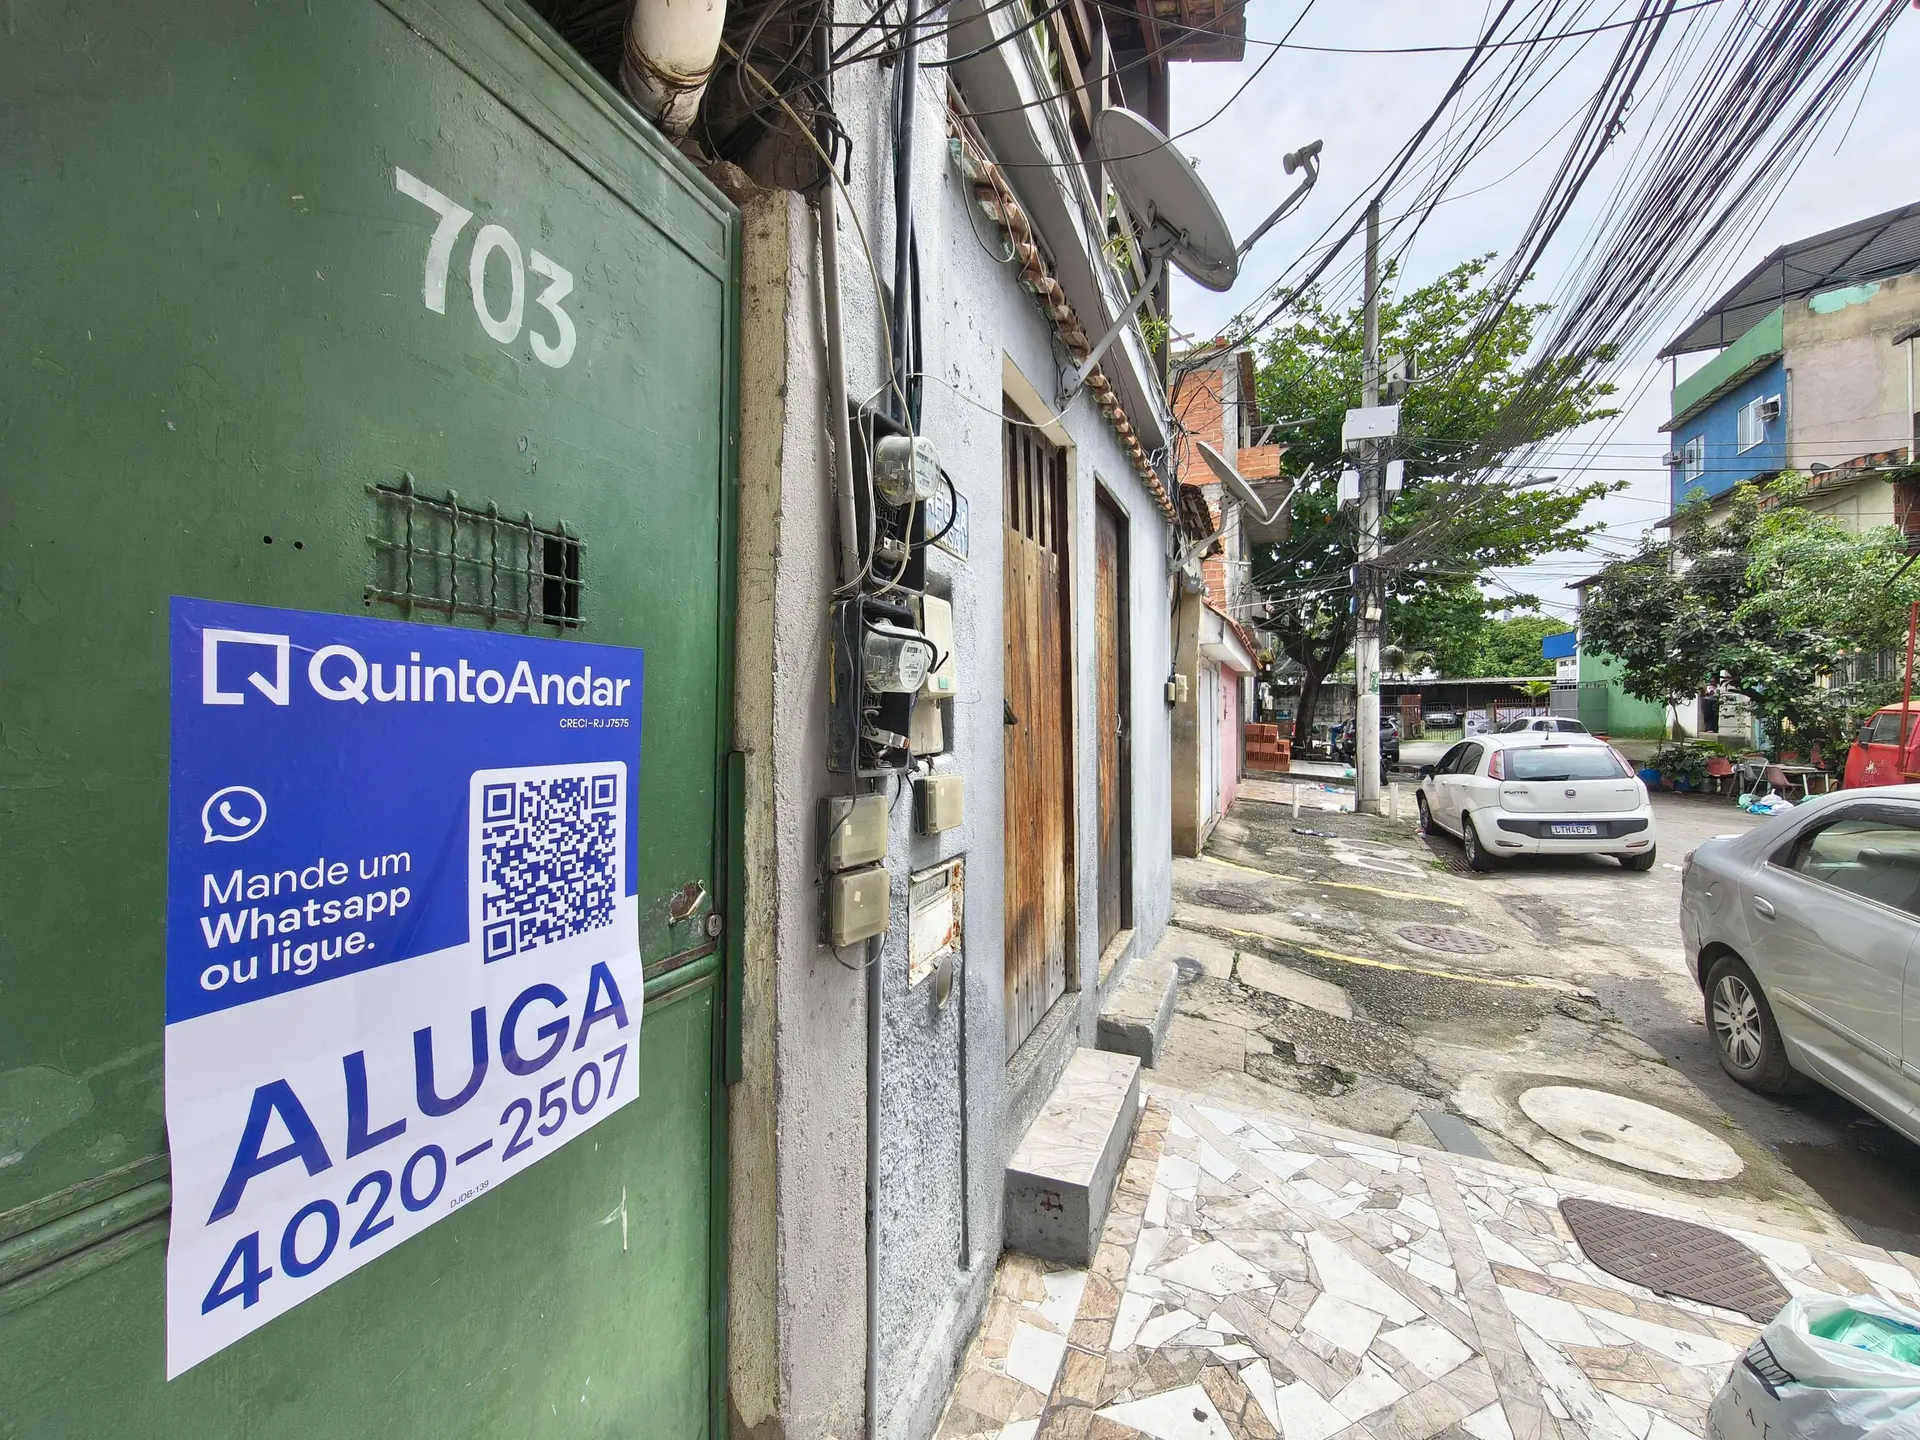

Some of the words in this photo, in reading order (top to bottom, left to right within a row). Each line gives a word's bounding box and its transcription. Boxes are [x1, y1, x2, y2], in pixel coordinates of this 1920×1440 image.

[395, 166, 577, 369] 703
[308, 644, 631, 707] QuintoAndar
[560, 718, 604, 728] CRECI-RJ
[606, 718, 629, 728] J7575
[202, 856, 349, 907] Mande
[358, 851, 411, 877] um
[200, 886, 411, 949] Whatsapp
[200, 961, 258, 991] ou
[271, 931, 375, 976] ligue.
[205, 961, 630, 1226] ALUGA
[201, 1043, 628, 1316] 4020-2507
[450, 1180, 489, 1208] DJDB-139
